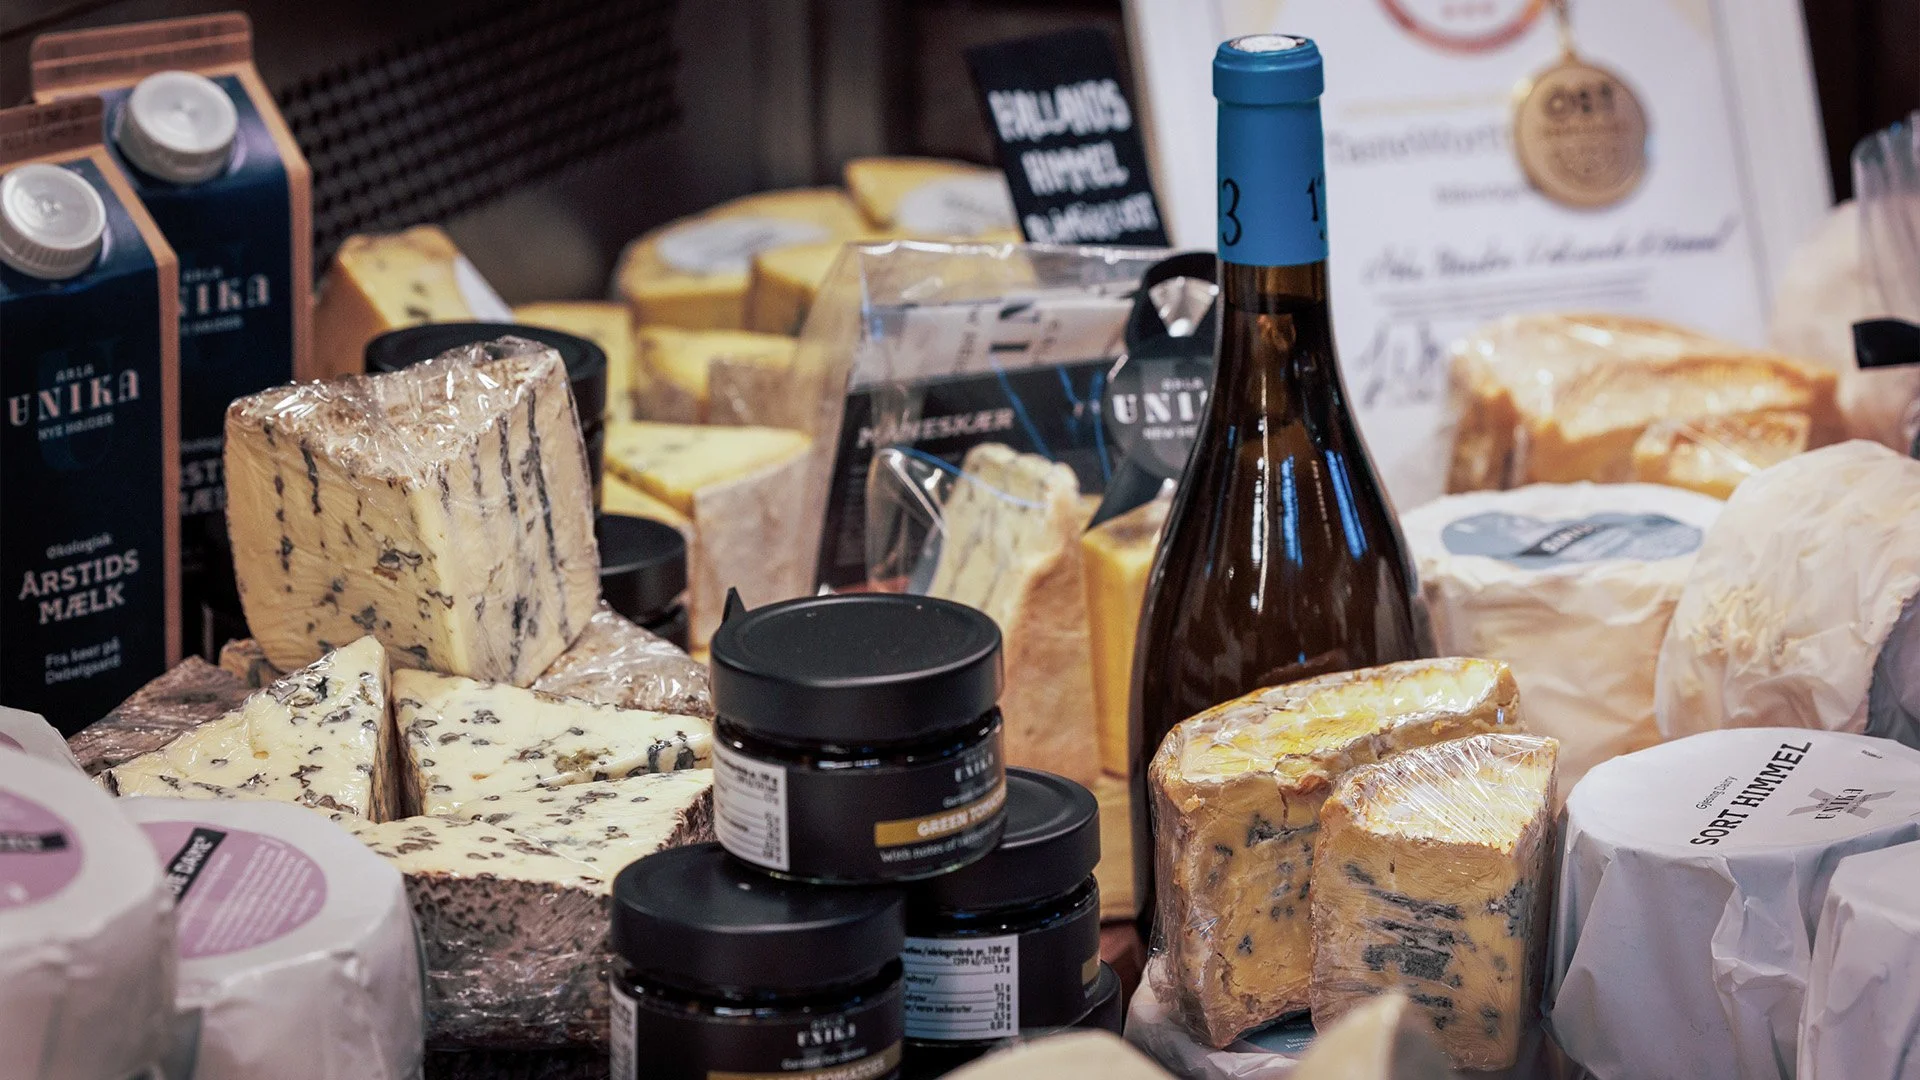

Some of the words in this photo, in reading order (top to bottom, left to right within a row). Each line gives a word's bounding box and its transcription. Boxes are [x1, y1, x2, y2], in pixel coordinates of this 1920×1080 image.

[9, 369, 139, 426] UNIKA
[18, 549, 139, 600] ÅRSTIDS
[39, 582, 125, 625] MÆLK
[1690, 808, 1749, 846] SORT
[1730, 741, 1812, 808] HIMMEL
[1814, 788, 1864, 819] UNIKA
[917, 811, 968, 837] GREEN
[880, 847, 912, 863] With
